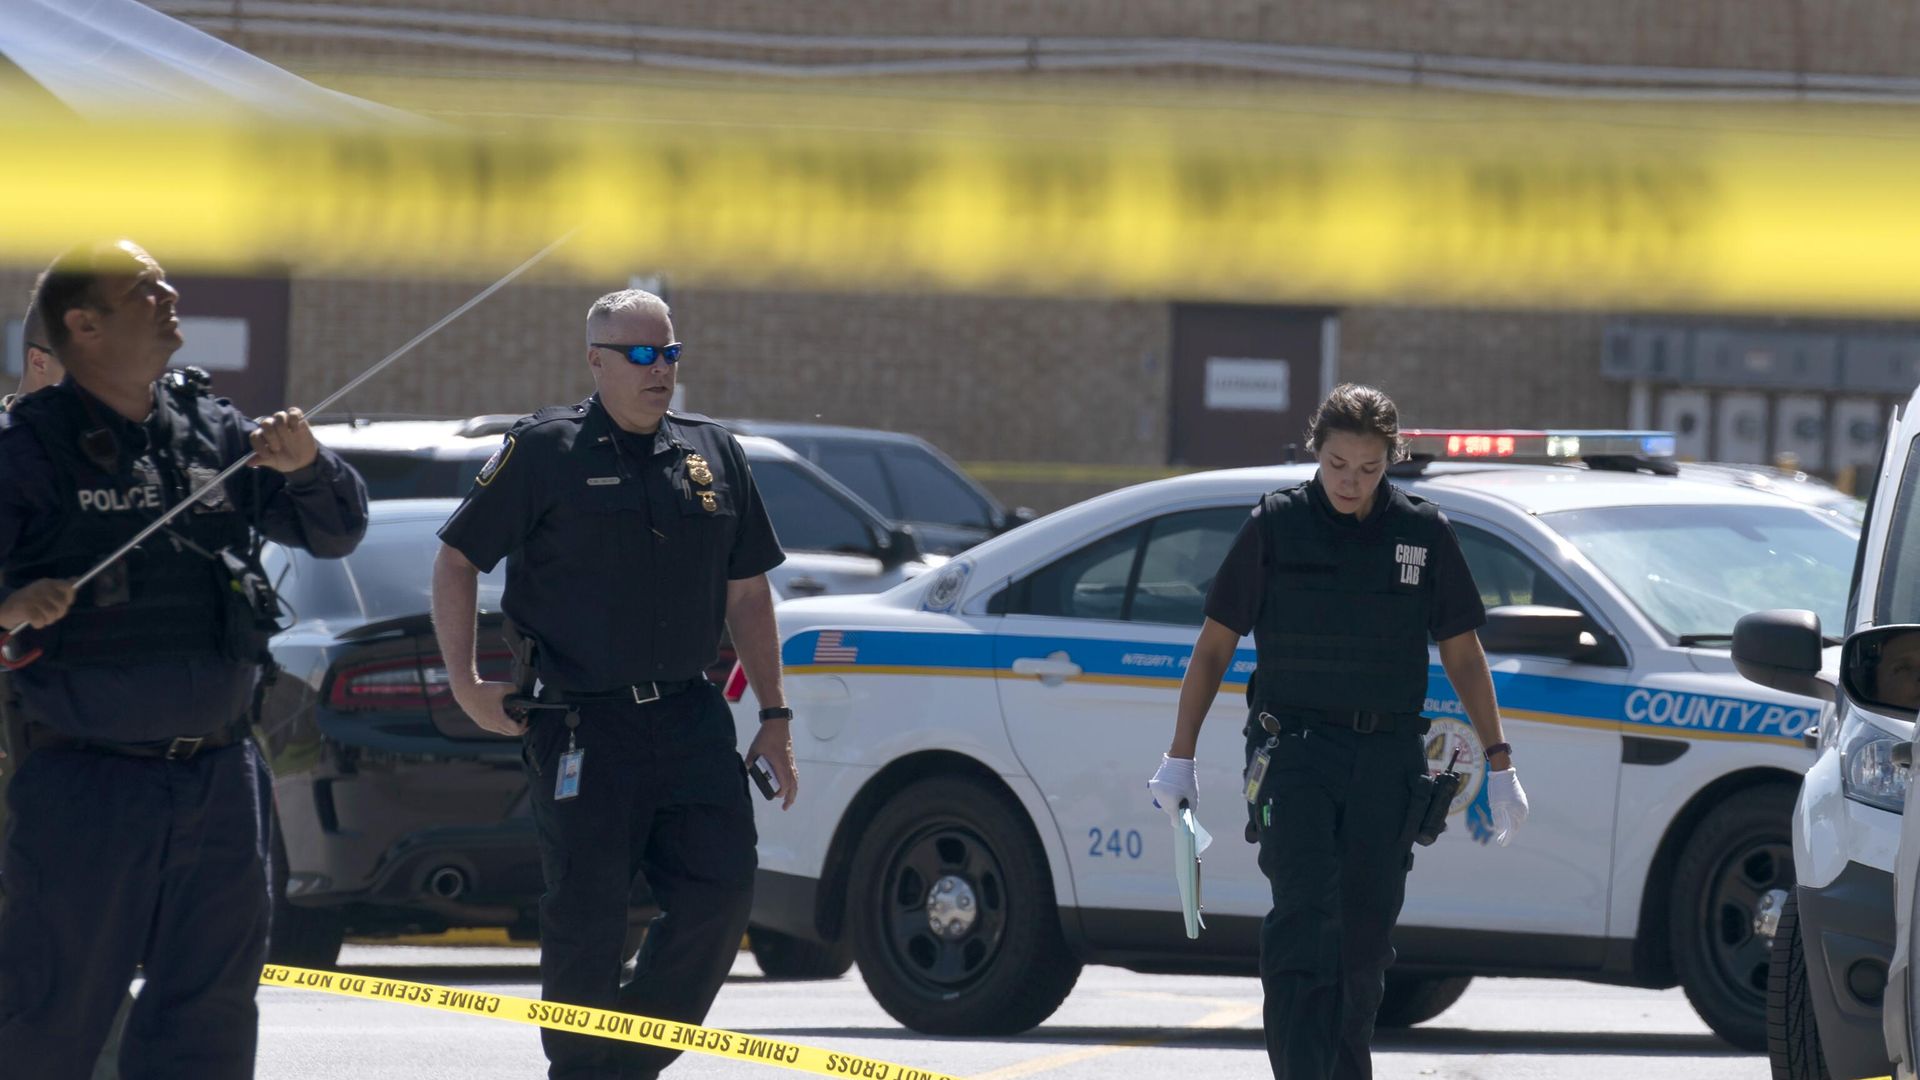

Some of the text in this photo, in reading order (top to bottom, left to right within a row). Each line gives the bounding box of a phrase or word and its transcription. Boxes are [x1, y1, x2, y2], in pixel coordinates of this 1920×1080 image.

[1396, 544, 1427, 567] CRIME
[1400, 564, 1420, 585] LAB
[1624, 689, 1761, 731] COUNTY
[1088, 826, 1142, 859] 240
[294, 972, 333, 988] NOT
[339, 977, 366, 993] DO
[370, 982, 433, 1003] SCENE
[437, 990, 501, 1013] CRIME
[527, 1003, 800, 1064] CRIME SCENE DO NOT CROSS
[826, 1053, 889, 1080] CROSS
